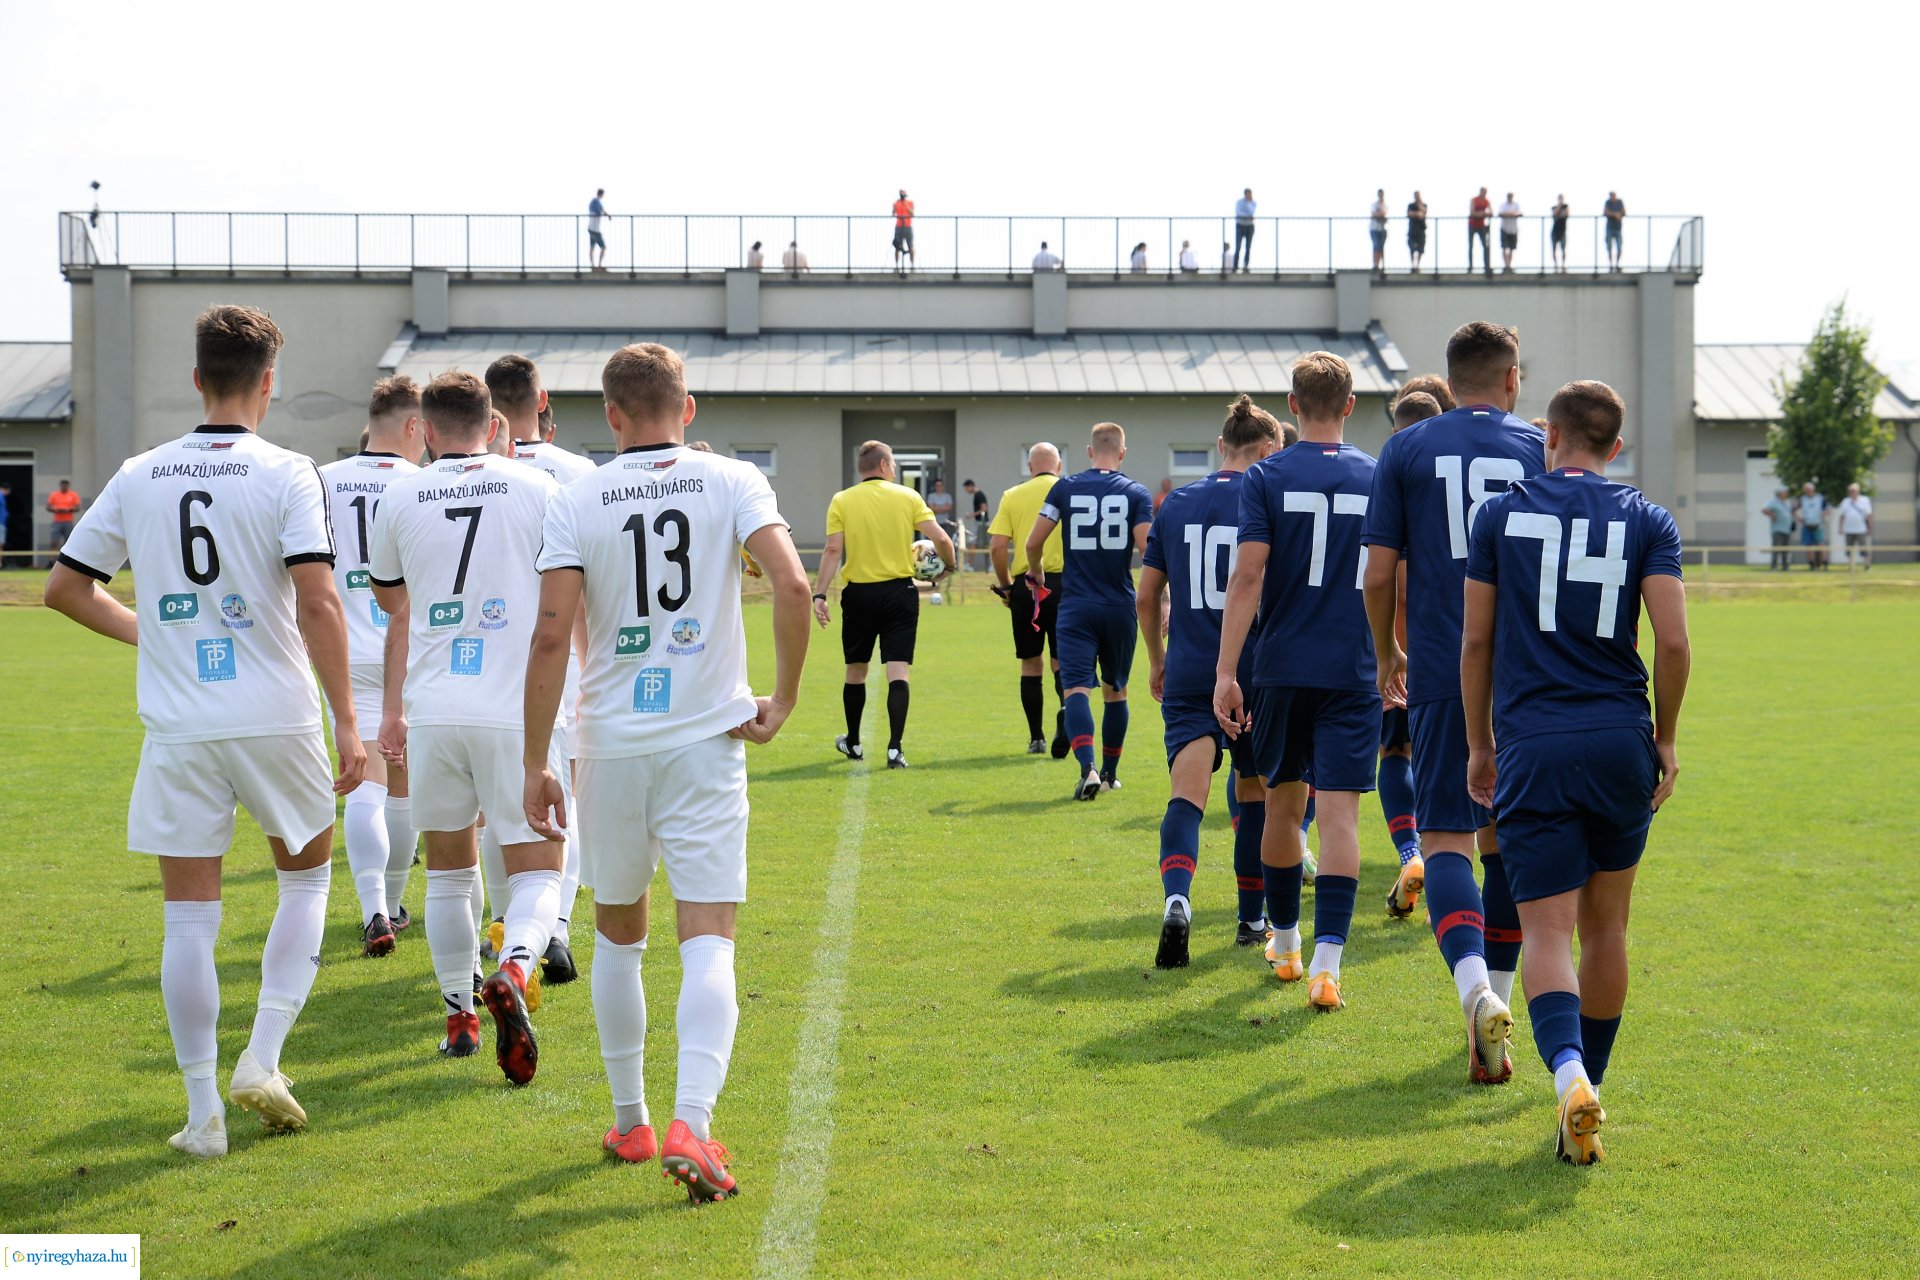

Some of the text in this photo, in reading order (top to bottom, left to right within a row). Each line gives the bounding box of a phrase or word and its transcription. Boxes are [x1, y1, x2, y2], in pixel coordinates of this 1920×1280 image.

[152, 461, 249, 480] BALMAZÚJVÁROS
[336, 482, 387, 493] BALMAZÚJ
[602, 477, 703, 506] BALMAZÚJVÁROS
[418, 481, 508, 503] BALMAZÚJVÁROS
[179, 490, 220, 586] 6
[349, 495, 380, 564] 1
[1070, 494, 1129, 550] 28
[444, 505, 483, 595] 7
[621, 508, 692, 618] 13
[1184, 524, 1238, 610] 10
[1504, 511, 1628, 639] 74
[166, 600, 193, 613] O-P
[434, 607, 460, 620] O-P
[617, 633, 646, 647] O-P
